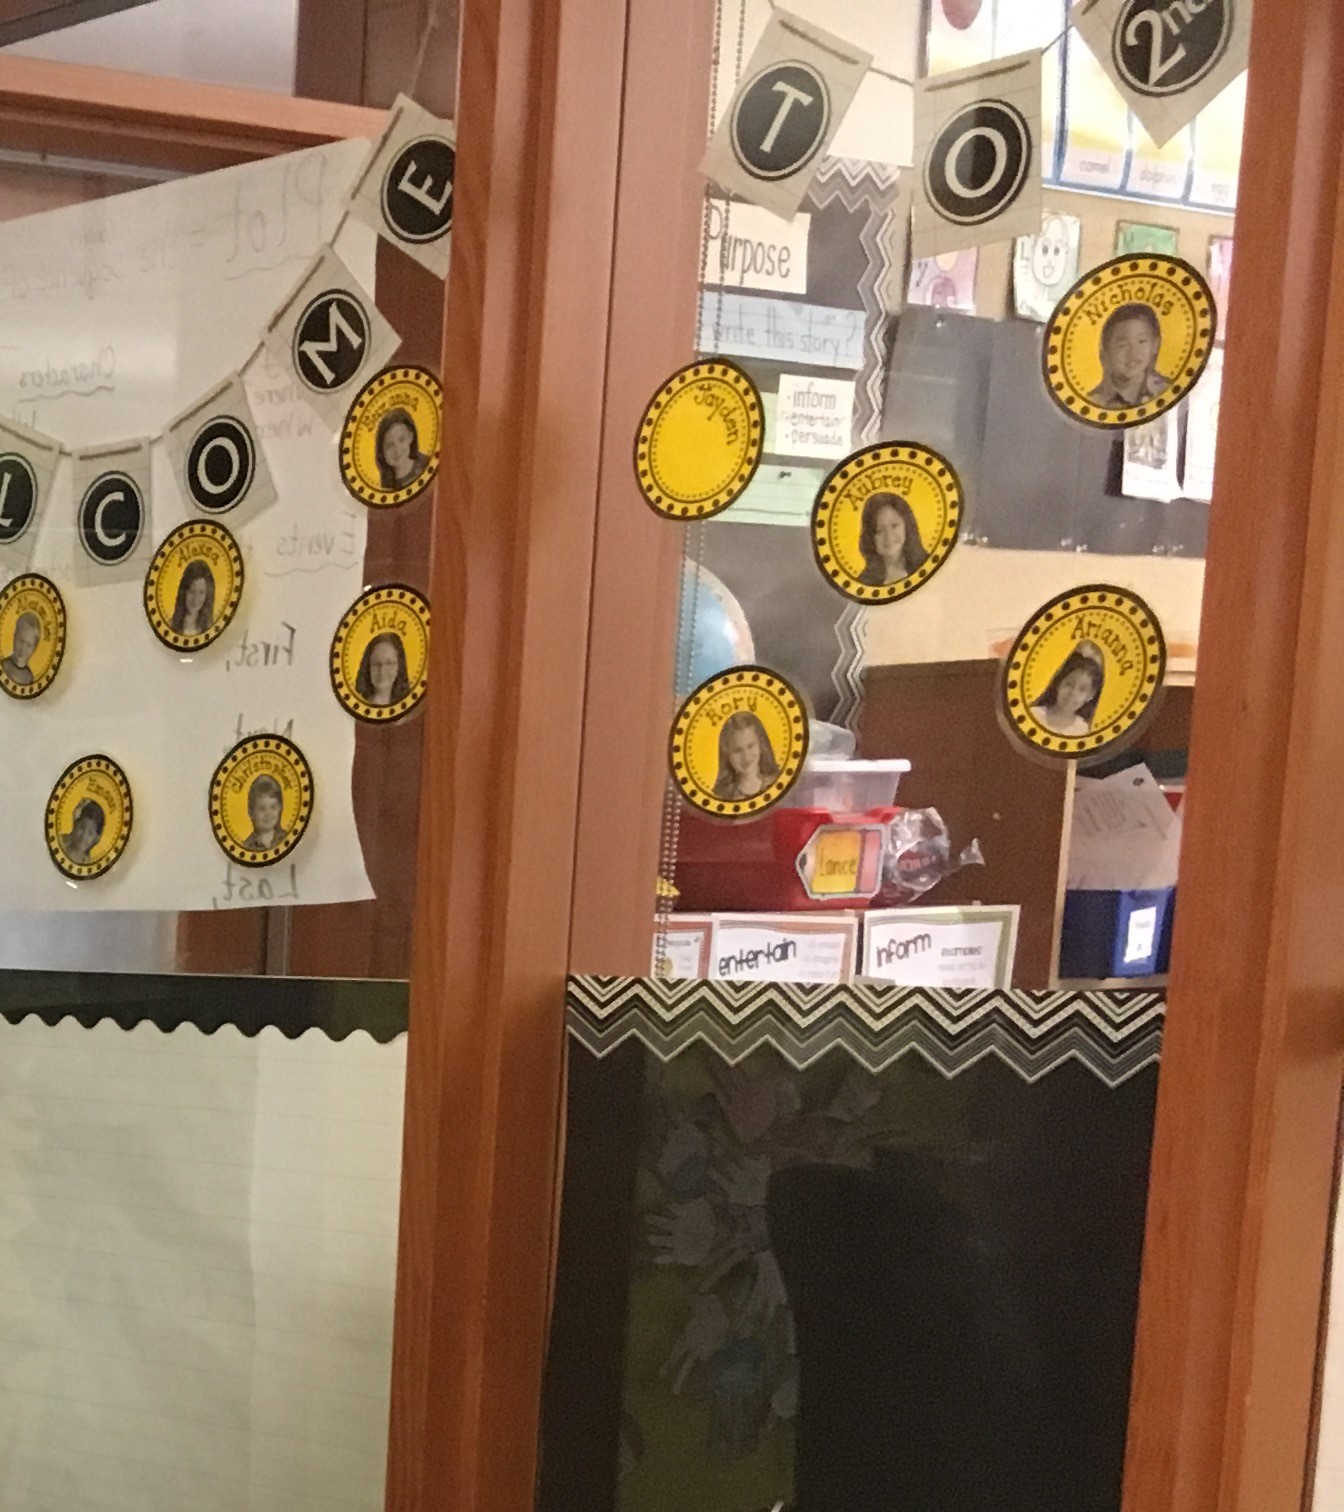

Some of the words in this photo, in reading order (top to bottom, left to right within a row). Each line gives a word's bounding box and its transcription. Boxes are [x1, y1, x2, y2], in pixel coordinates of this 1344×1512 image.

[708, 204, 790, 286] Purpose
[1083, 282, 1174, 327] Nicholas
[692, 385, 739, 446] Jayden
[842, 475, 913, 512] Aubrey
[370, 611, 407, 637] Aida
[1071, 616, 1145, 677] Arianna
[705, 697, 757, 727] Rory
[820, 848, 858, 877] Lance
[718, 938, 798, 978] entertain
[877, 934, 931, 969] inform
